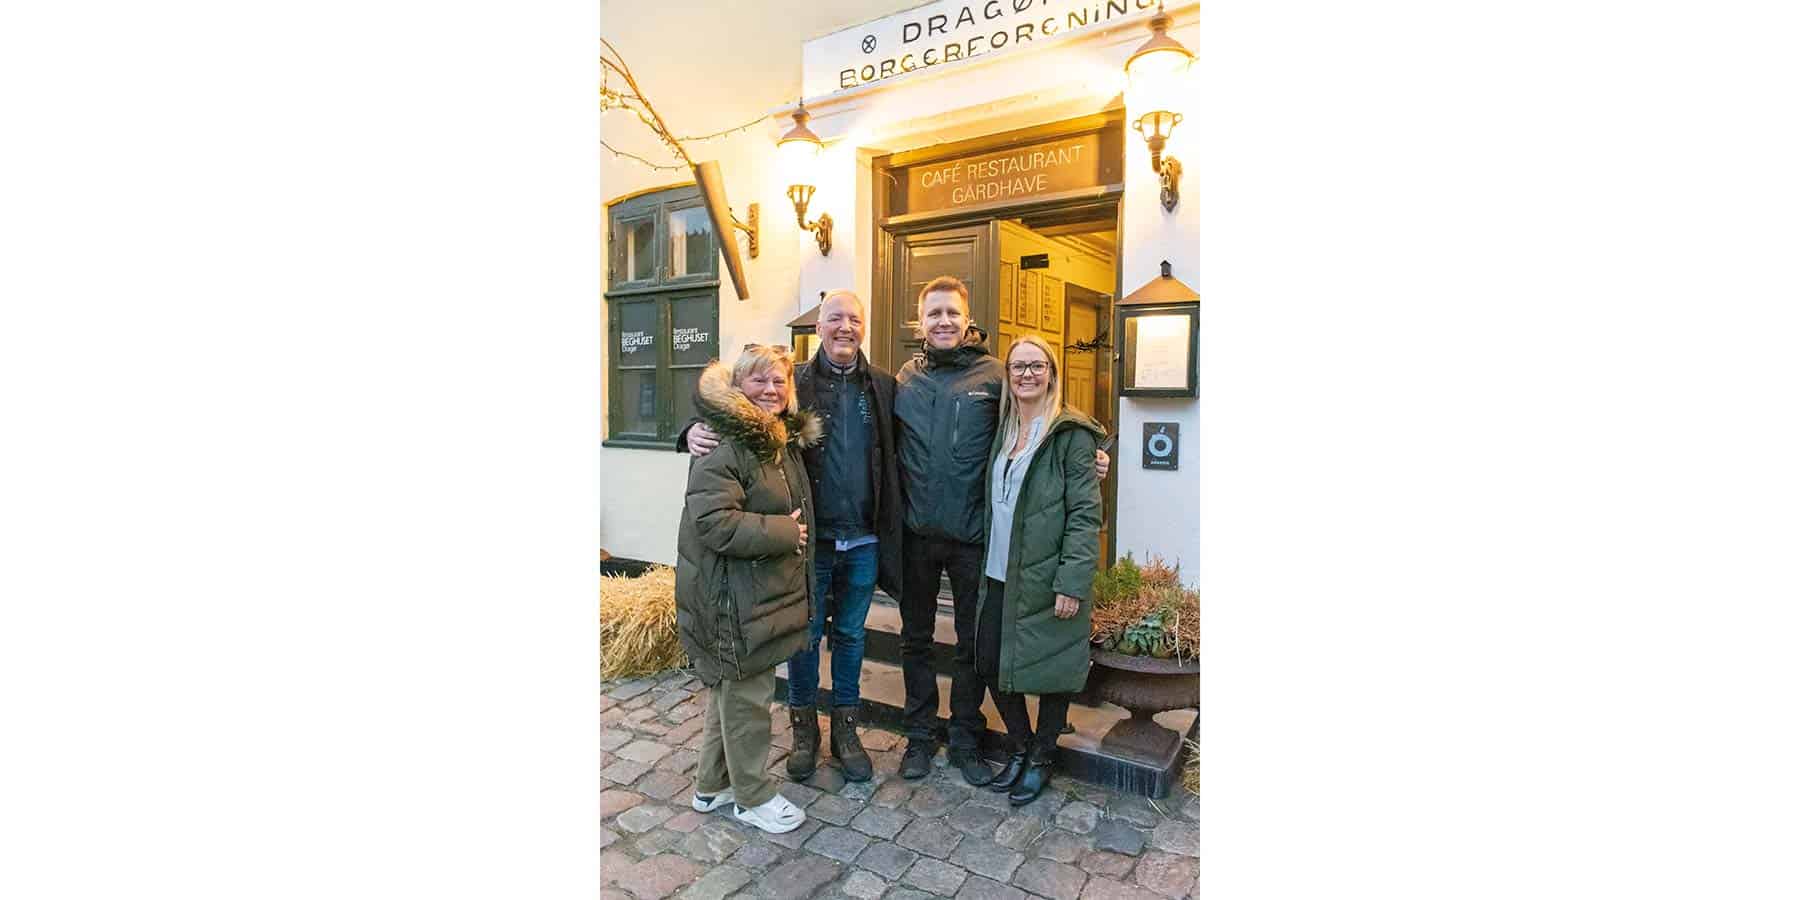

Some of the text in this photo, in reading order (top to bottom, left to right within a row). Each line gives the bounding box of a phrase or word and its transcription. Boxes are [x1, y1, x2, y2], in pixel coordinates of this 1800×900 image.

[902, 0, 1048, 44] DRAGØ
[921, 145, 1083, 188] CAFÉ RESTAURANT
